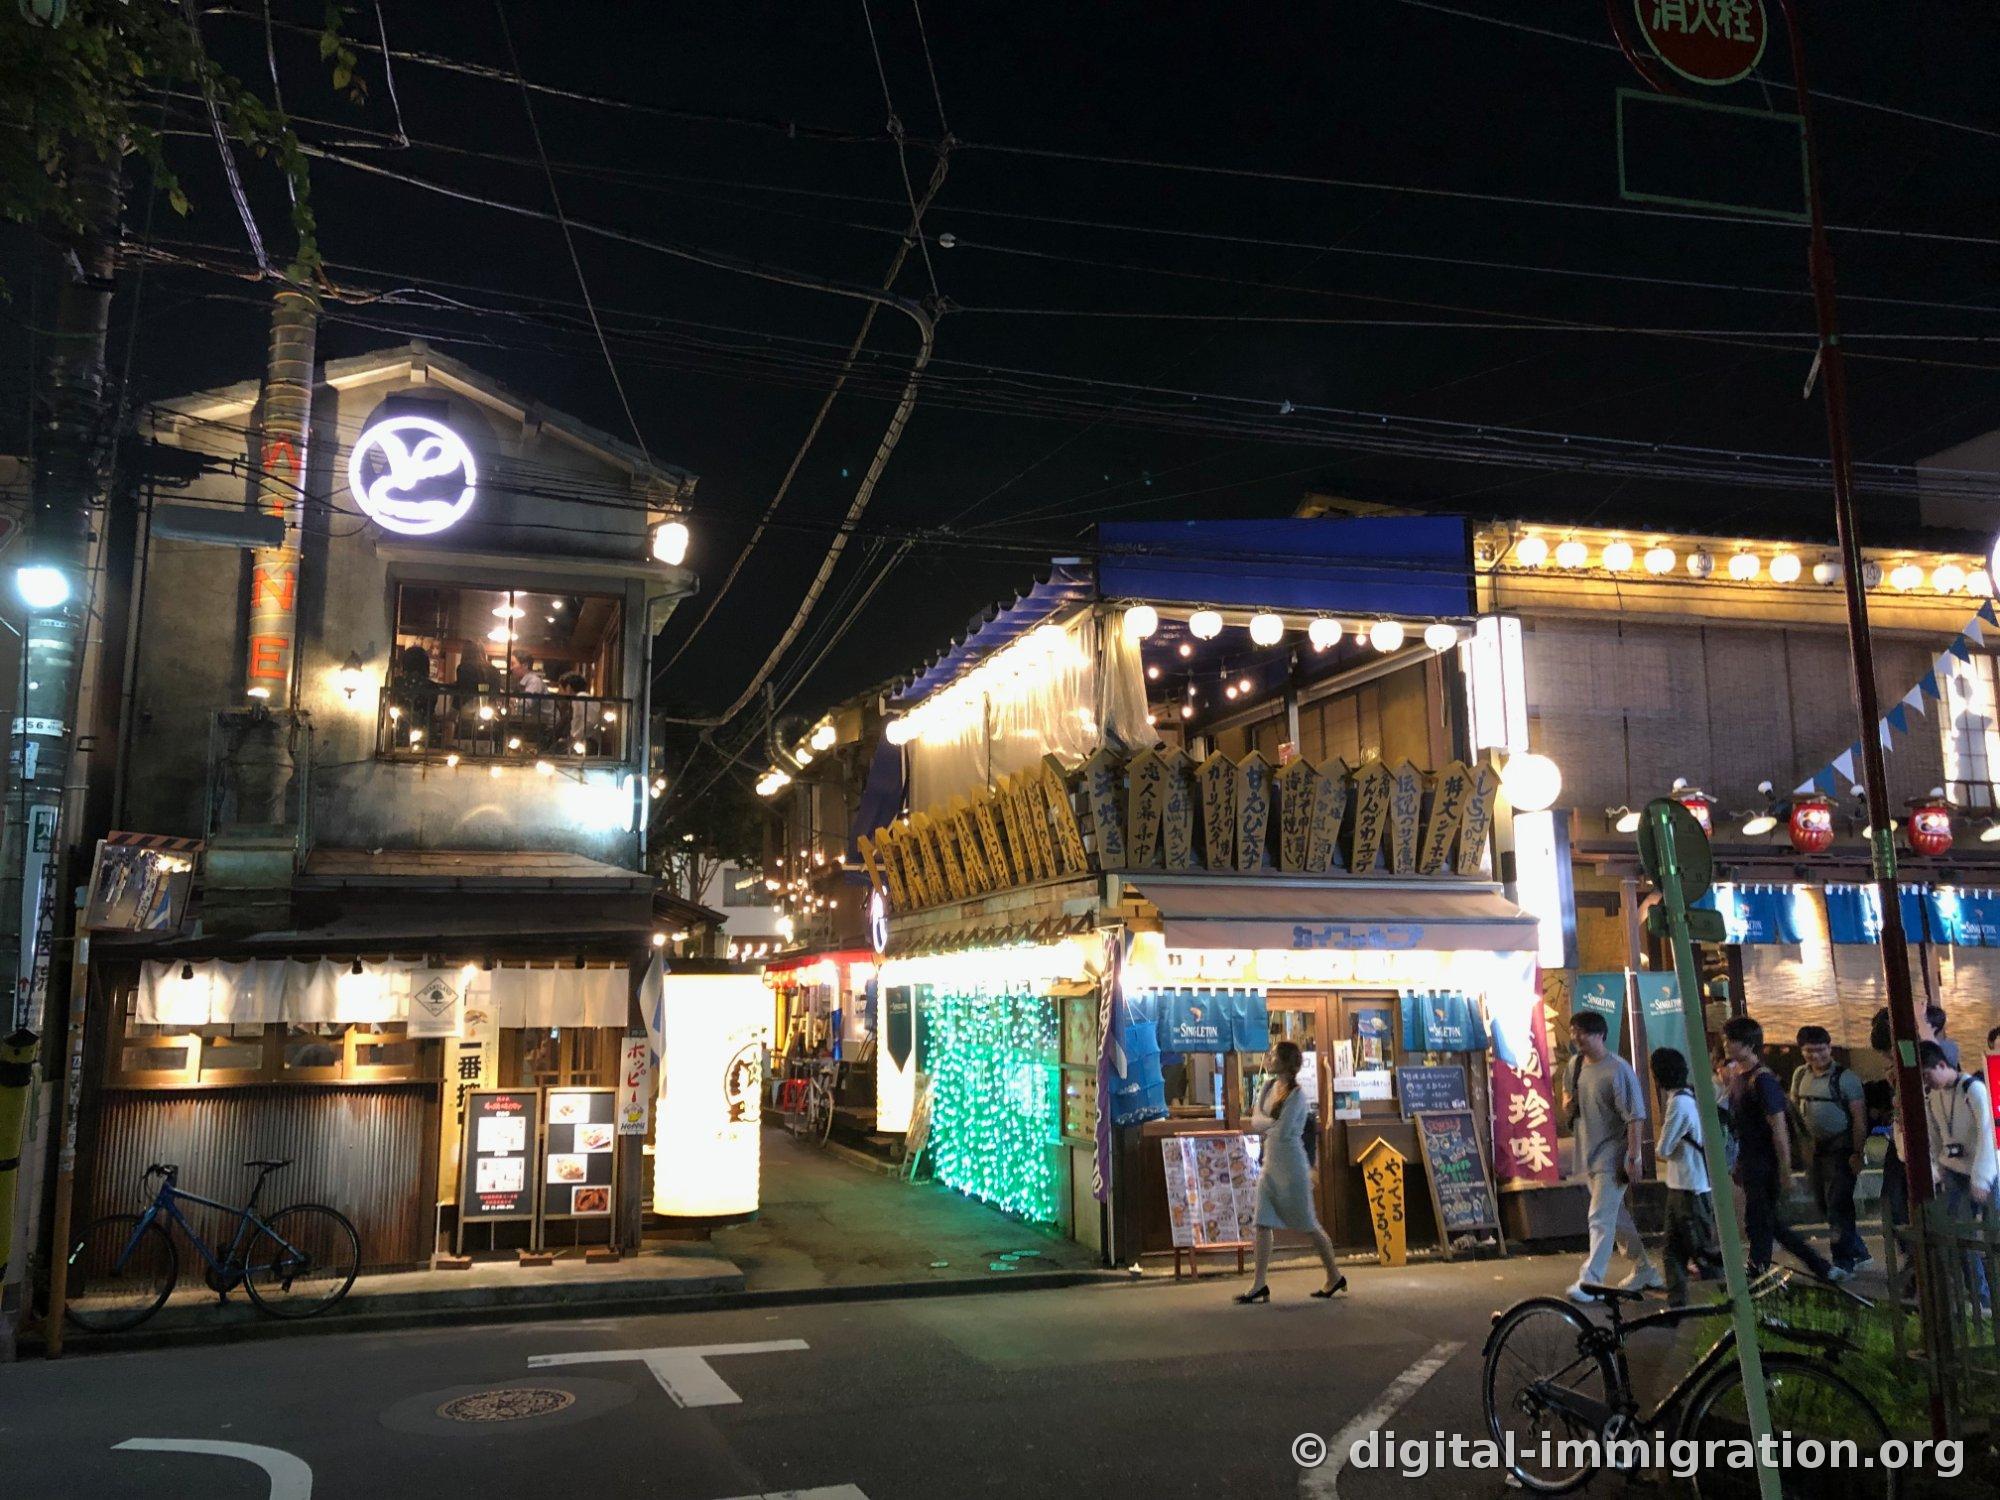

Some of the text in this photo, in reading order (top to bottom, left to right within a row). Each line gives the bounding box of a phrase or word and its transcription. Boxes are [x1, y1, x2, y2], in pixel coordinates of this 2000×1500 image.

[1652, 0, 1756, 42] 消火栓
[1180, 1022, 1218, 1038] SINGLETON
[627, 1043, 647, 1103] ホッピー
[1385, 1158, 1403, 1222] やってる
